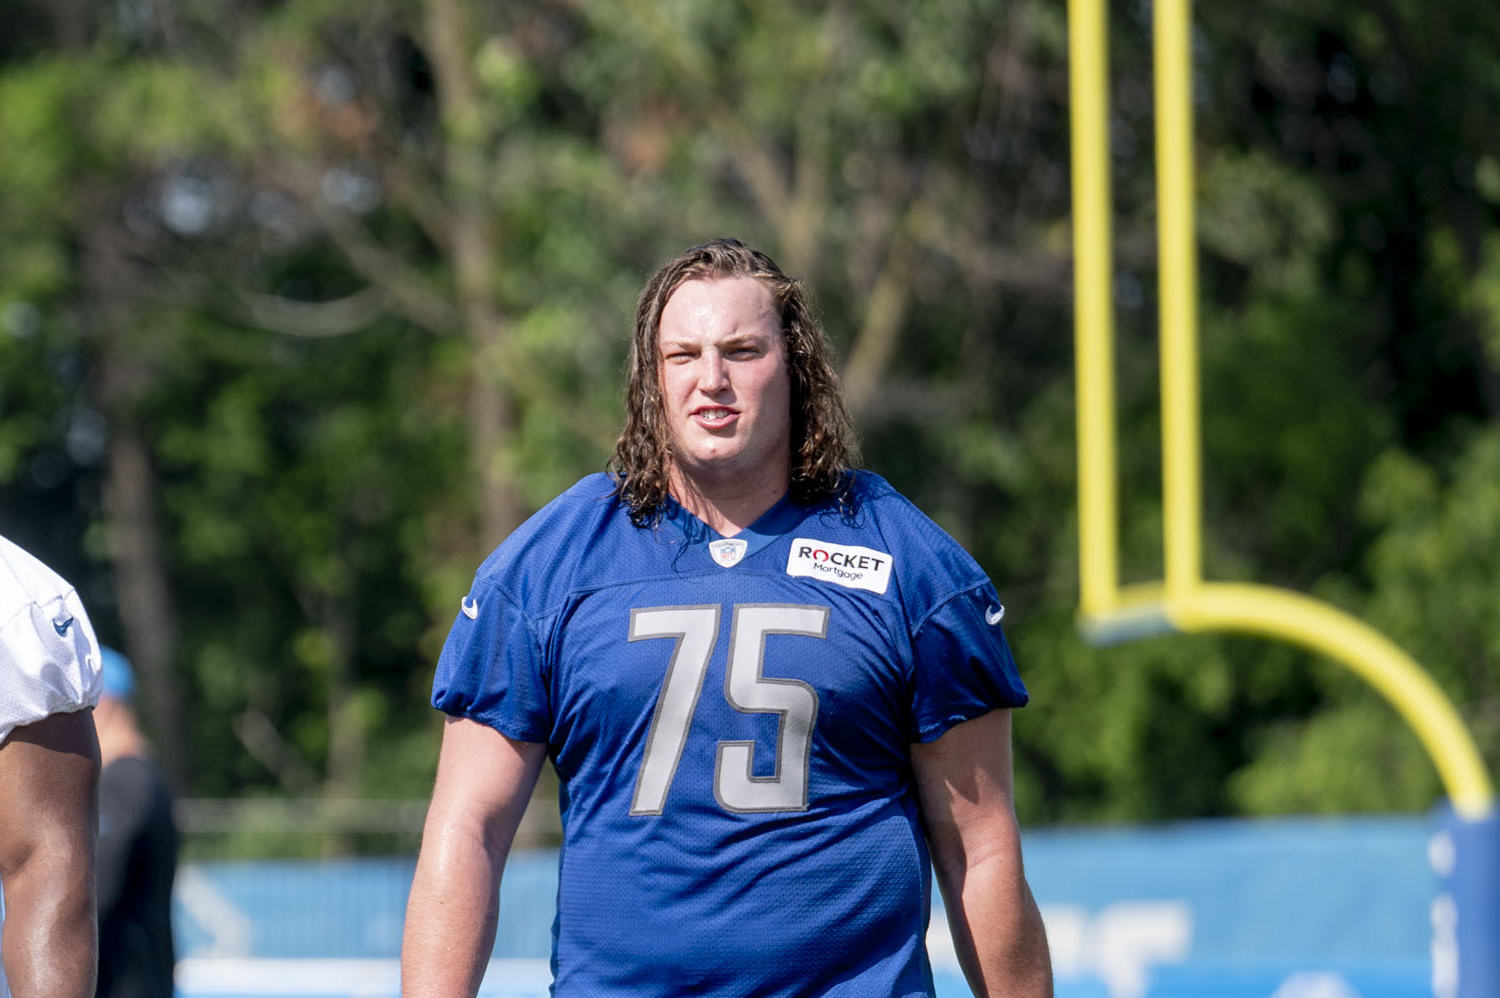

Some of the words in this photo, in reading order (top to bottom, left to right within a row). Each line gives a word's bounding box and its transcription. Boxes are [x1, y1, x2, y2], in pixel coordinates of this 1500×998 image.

[798, 546, 884, 571] ROCKET
[813, 562, 863, 580] Mortgage
[628, 603, 830, 816] 75
